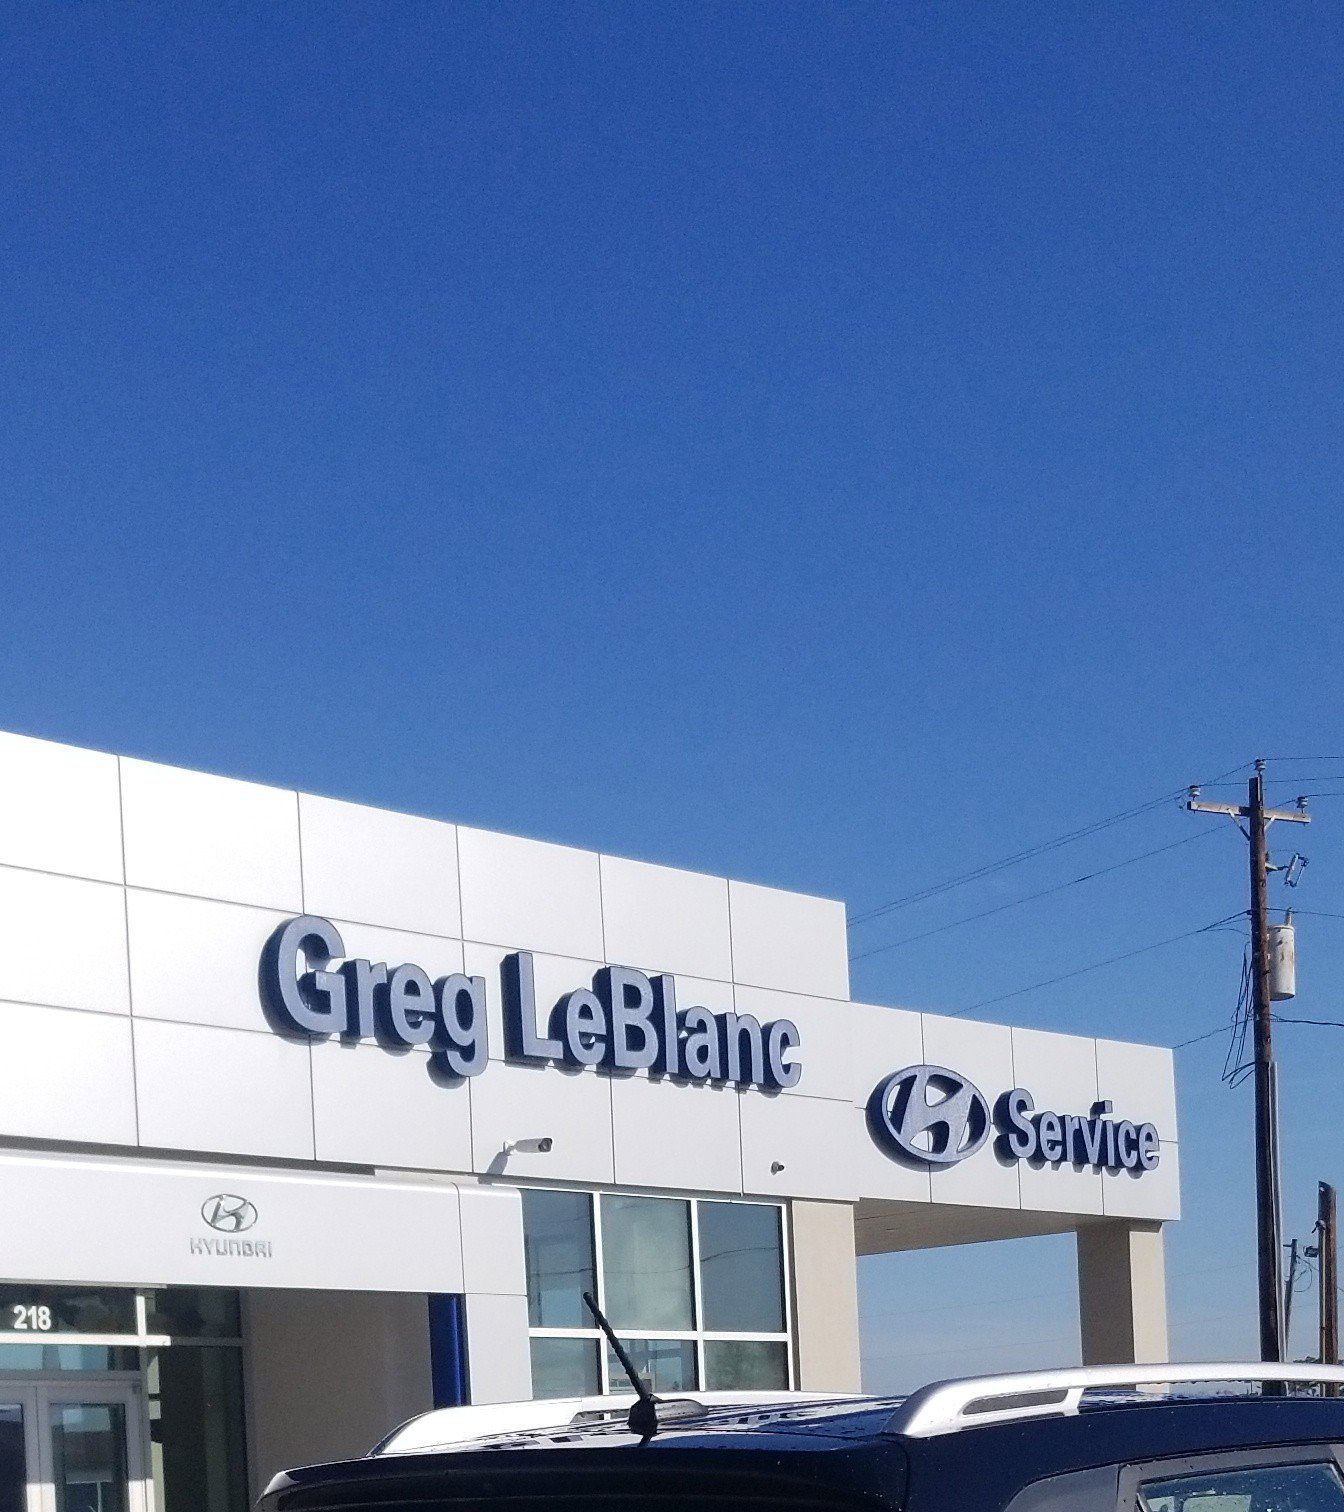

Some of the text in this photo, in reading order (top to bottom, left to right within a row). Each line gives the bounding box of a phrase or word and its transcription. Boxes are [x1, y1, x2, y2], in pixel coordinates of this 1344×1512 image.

[258, 915, 802, 1096] Greg LeBlanc
[994, 1088, 1160, 1178] Service
[189, 1237, 273, 1258] HYUNDAI
[13, 1304, 52, 1331] 218
